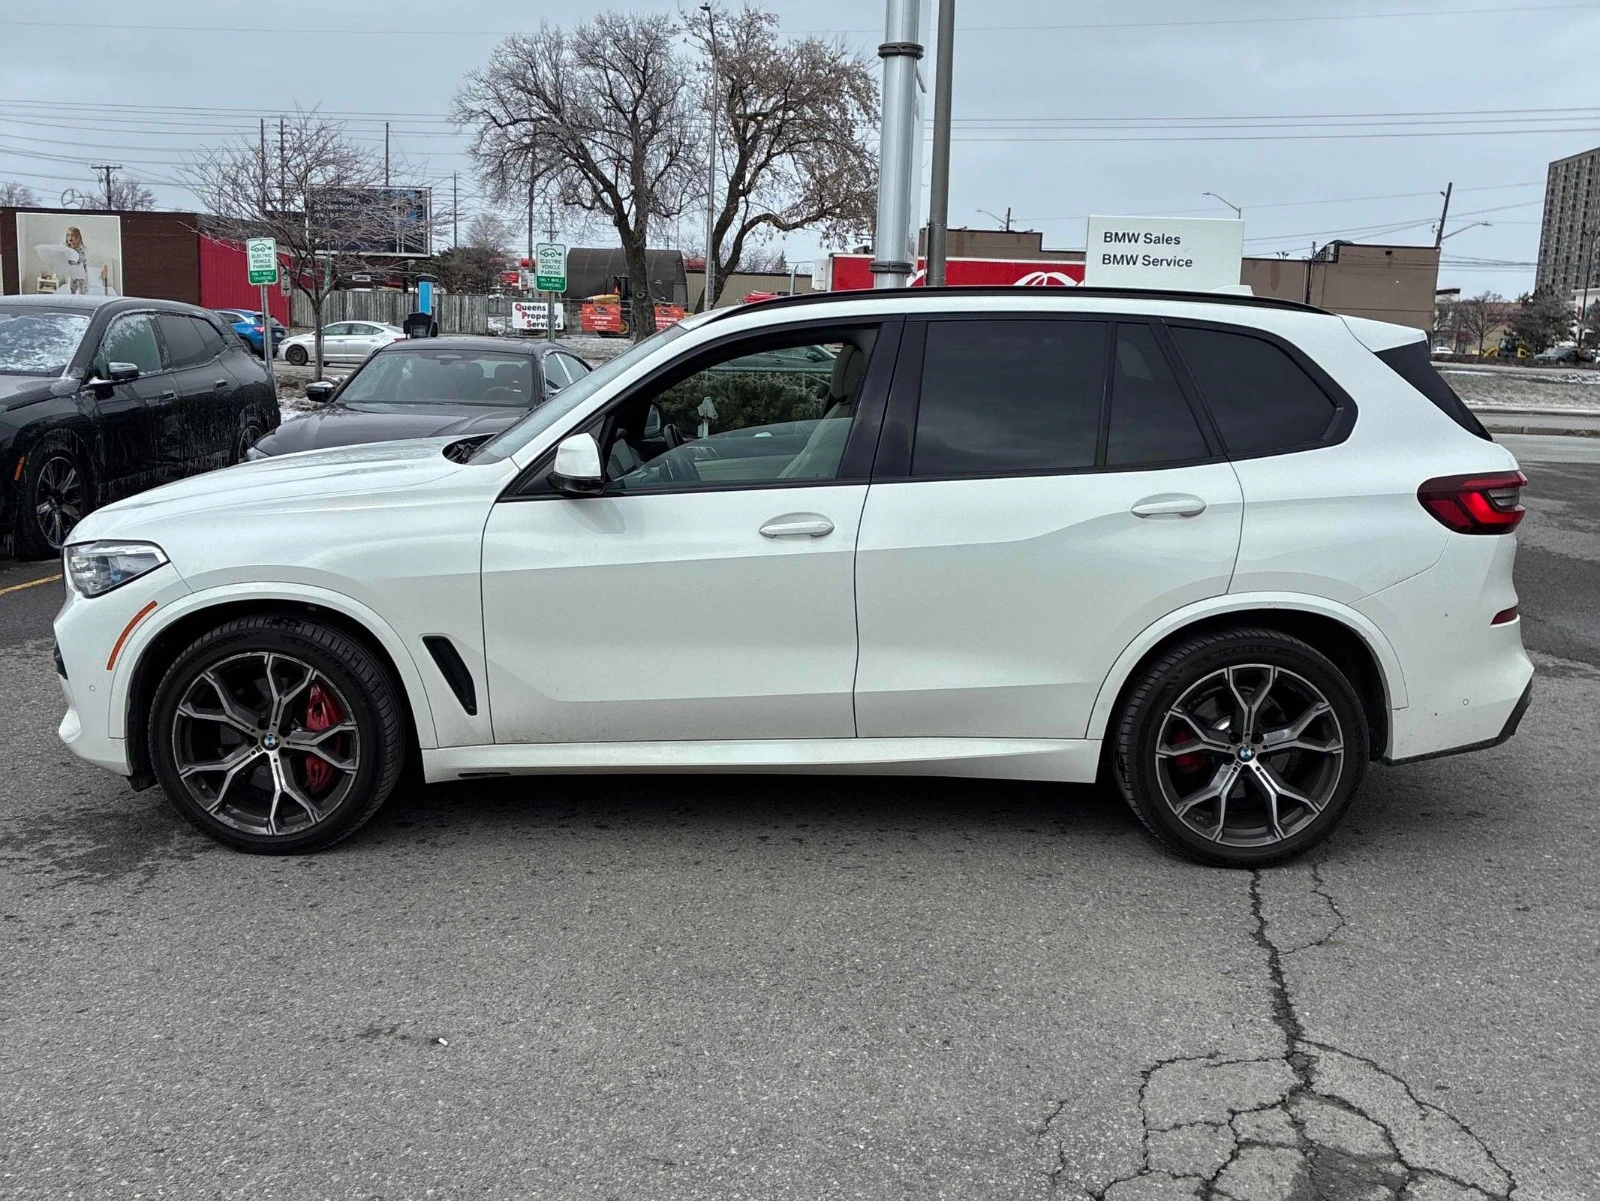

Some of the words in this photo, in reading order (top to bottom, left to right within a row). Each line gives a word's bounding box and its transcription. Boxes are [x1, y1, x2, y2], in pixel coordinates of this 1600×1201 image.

[1103, 231, 1140, 244] BMW
[1143, 232, 1181, 245] Sales
[1101, 253, 1139, 266] BMW
[1141, 254, 1193, 268] Service
[514, 303, 546, 312] Queens
[521, 311, 559, 321] Propery
[526, 320, 561, 328] Servis
